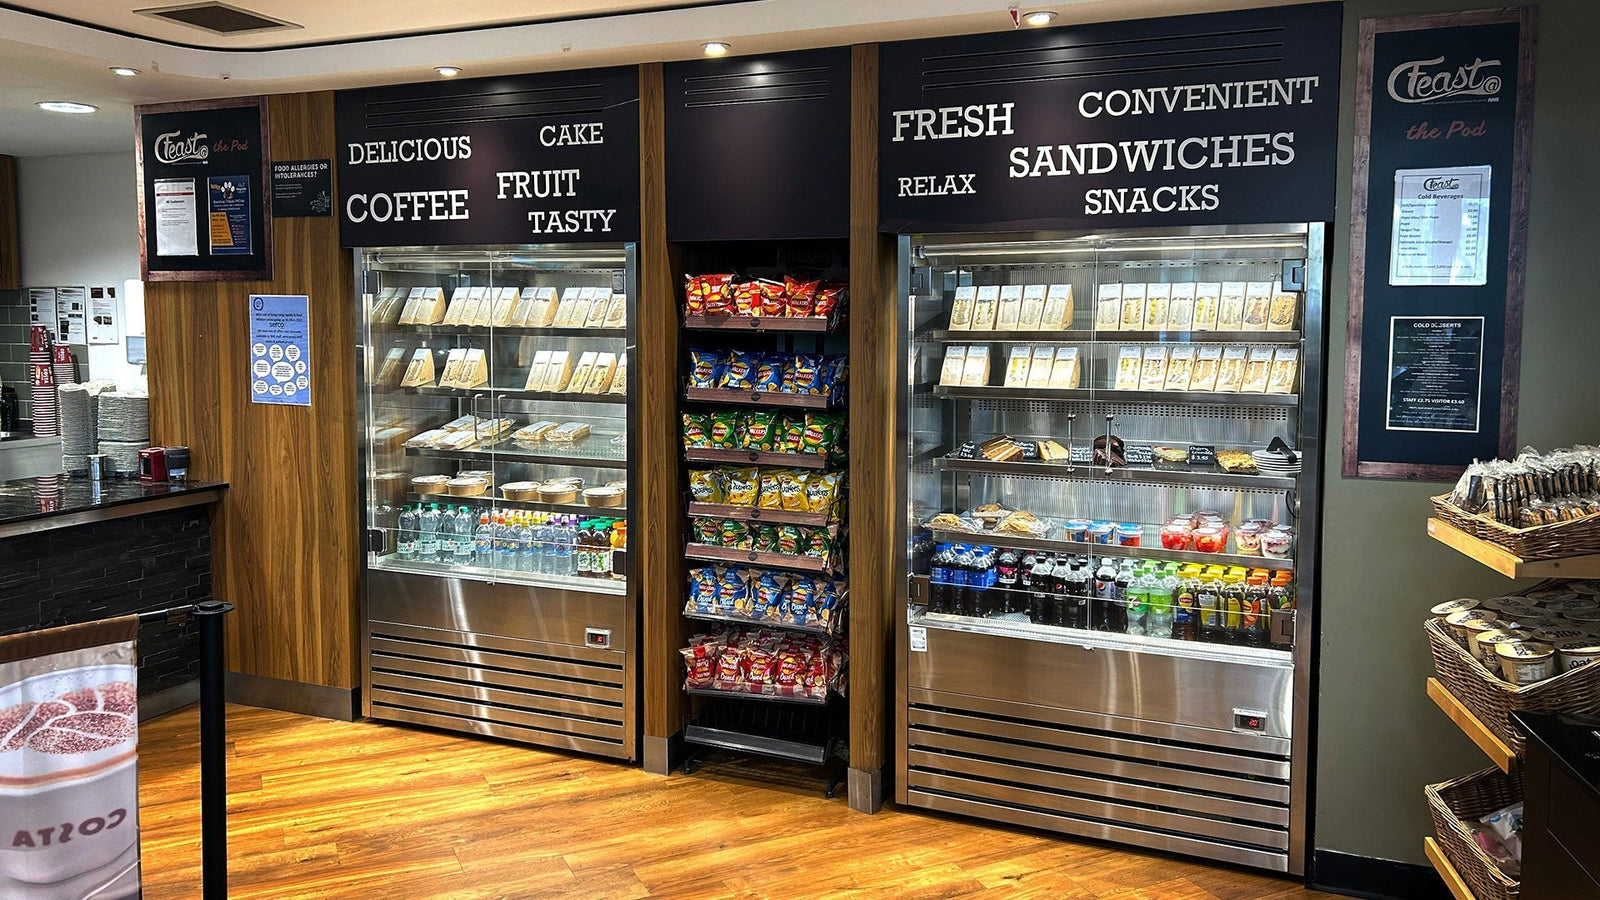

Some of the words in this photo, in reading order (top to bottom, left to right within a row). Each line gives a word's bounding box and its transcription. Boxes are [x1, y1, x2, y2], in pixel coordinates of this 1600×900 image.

[1078, 76, 1320, 118] CONVENIENT
[539, 122, 604, 147] CAKE
[892, 102, 1015, 142] FRESH
[1404, 121, 1442, 140] the
[1445, 120, 1487, 139] Pod
[213, 140, 229, 152] the
[231, 139, 248, 152] Pod
[348, 135, 472, 165] DELICIOUS
[1008, 132, 1296, 178] SANDWICHES
[290, 163, 319, 171] ALLERGIES
[496, 168, 580, 199] FRUIT
[898, 174, 976, 197] RELAX
[346, 189, 469, 223] COFFEE
[1084, 184, 1220, 216] SNACKS
[528, 209, 616, 233] TASTY
[795, 372, 814, 380] WALKERS
